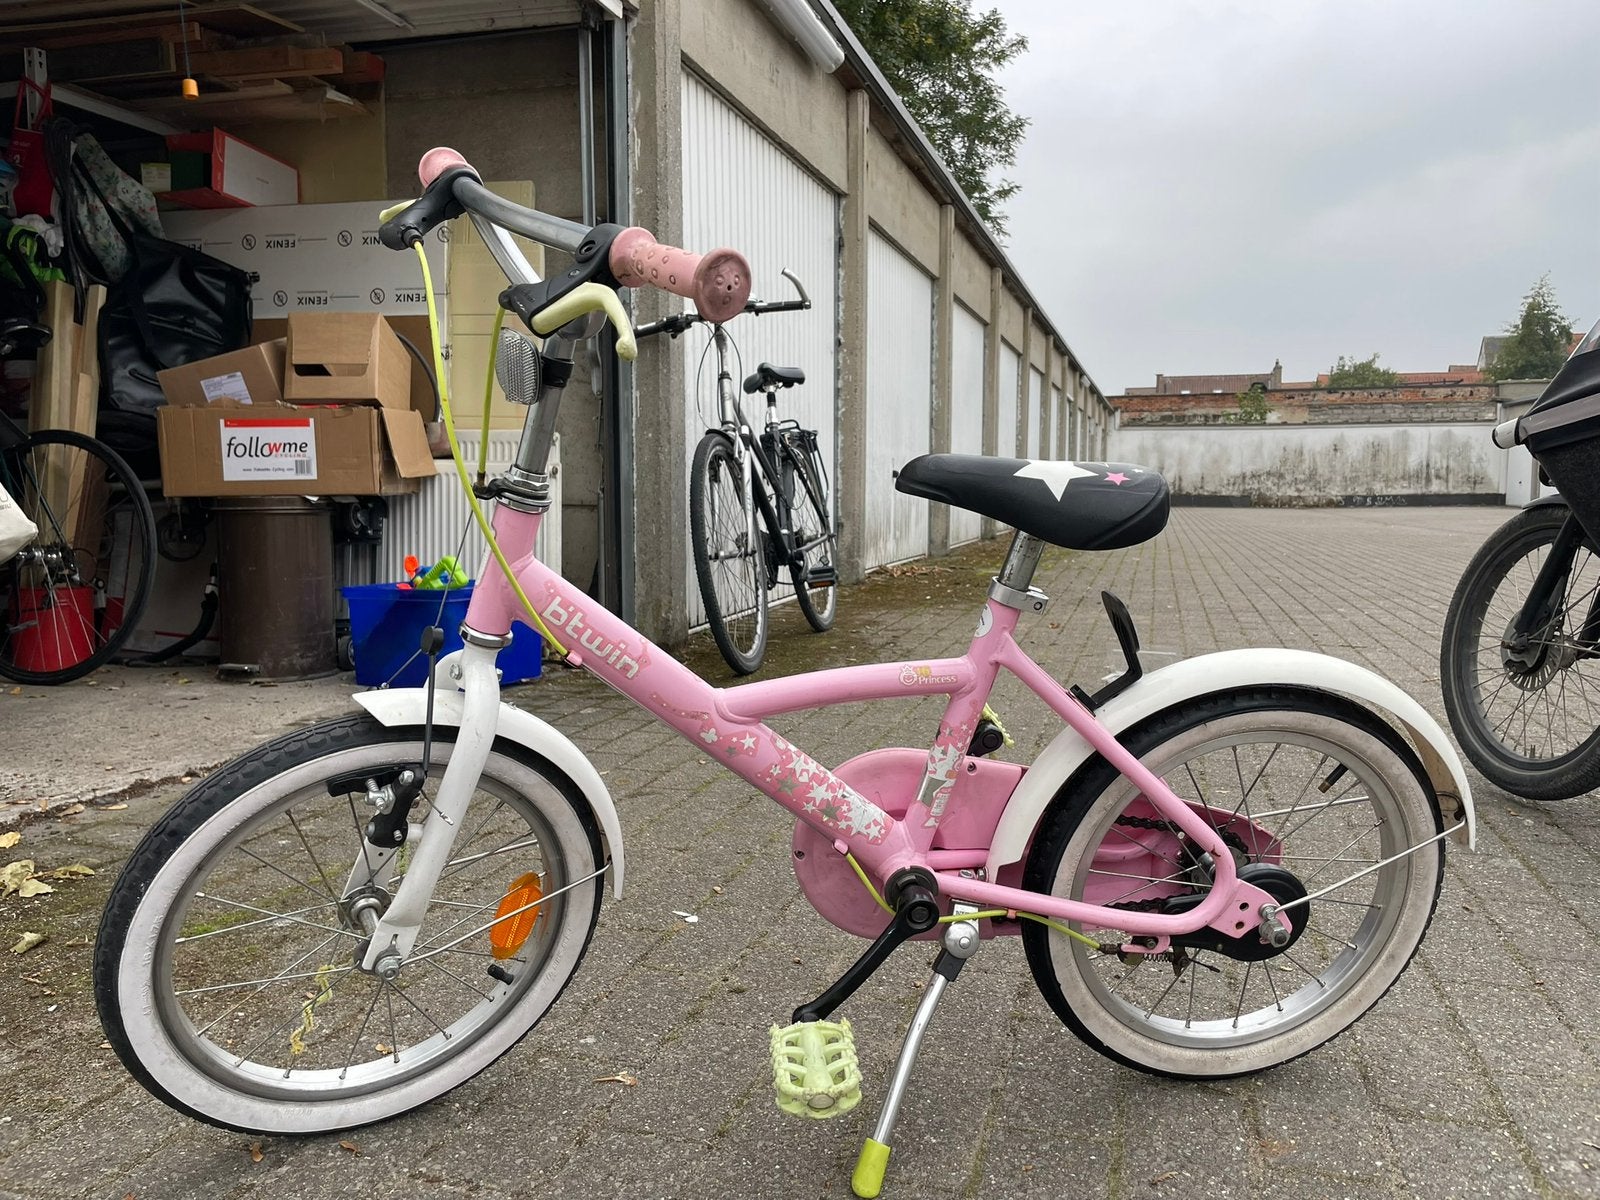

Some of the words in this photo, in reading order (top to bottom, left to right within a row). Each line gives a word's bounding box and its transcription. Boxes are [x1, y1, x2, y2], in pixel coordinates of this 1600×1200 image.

[265, 239, 296, 249] FENIX
[362, 235, 383, 246] NIX
[297, 295, 328, 306] FENIX
[395, 293, 427, 303] FENIX
[918, 675, 957, 685] Princess
